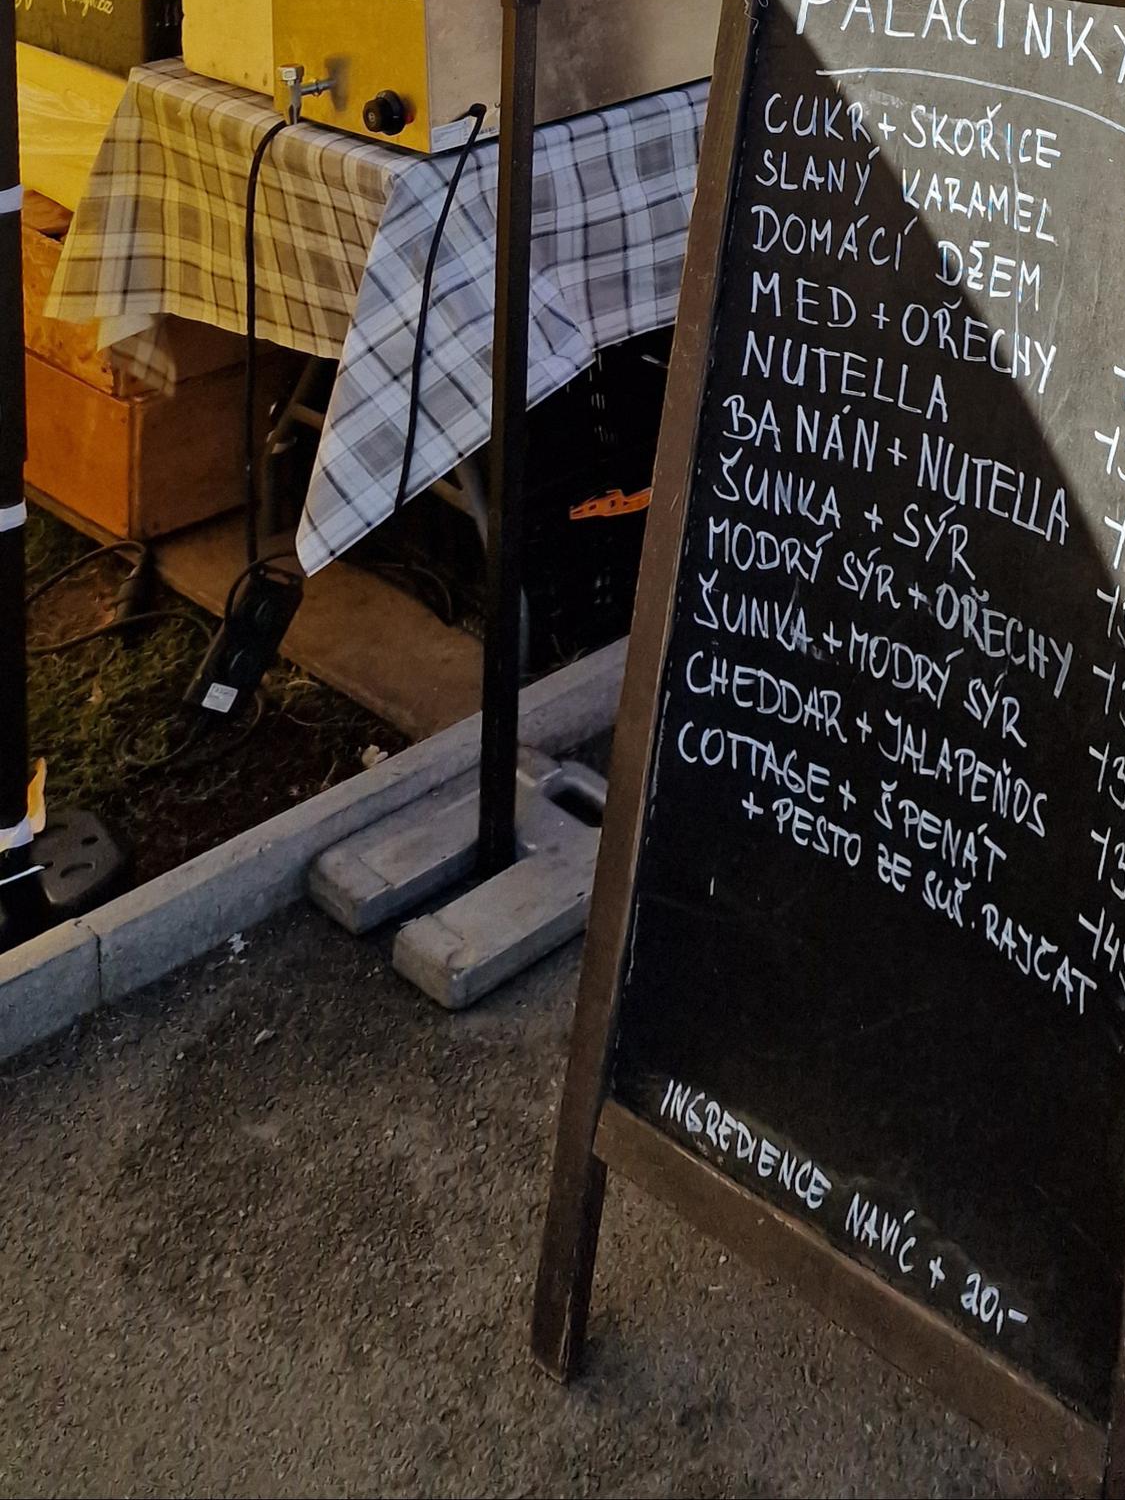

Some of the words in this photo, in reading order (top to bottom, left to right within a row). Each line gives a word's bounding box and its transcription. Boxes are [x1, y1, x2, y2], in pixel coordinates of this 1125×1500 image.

[763, 92, 875, 144] CUKR
[901, 102, 1061, 169] SKOŘICE
[750, 204, 919, 272] DOMÁCÍ
[754, 146, 881, 207] SLANÝ
[901, 167, 1059, 246] KARAMEL
[741, 330, 949, 423] NUTELLA
[750, 271, 857, 329] MED
[900, 300, 1058, 395] OŘECHY
[712, 447, 841, 530] ŠUNKA
[893, 503, 976, 580] SÝR
[722, 394, 880, 473] BANÁN
[916, 433, 1070, 546] NUTELLA
[693, 568, 814, 655] ŠUNKA
[847, 621, 965, 709] MODRÝ
[963, 672, 1027, 748] SÝR
[708, 515, 834, 584] MODRÝ
[837, 547, 901, 609] SÝR
[935, 583, 1074, 698] OŘECHY
[685, 650, 847, 744] CHEDDAR
[677, 721, 831, 804] COTTAGE
[873, 779, 1007, 883] ŠPENÁT
[772, 798, 863, 868] PESTO
[660, 1078, 832, 1210] INGREDIENCE
